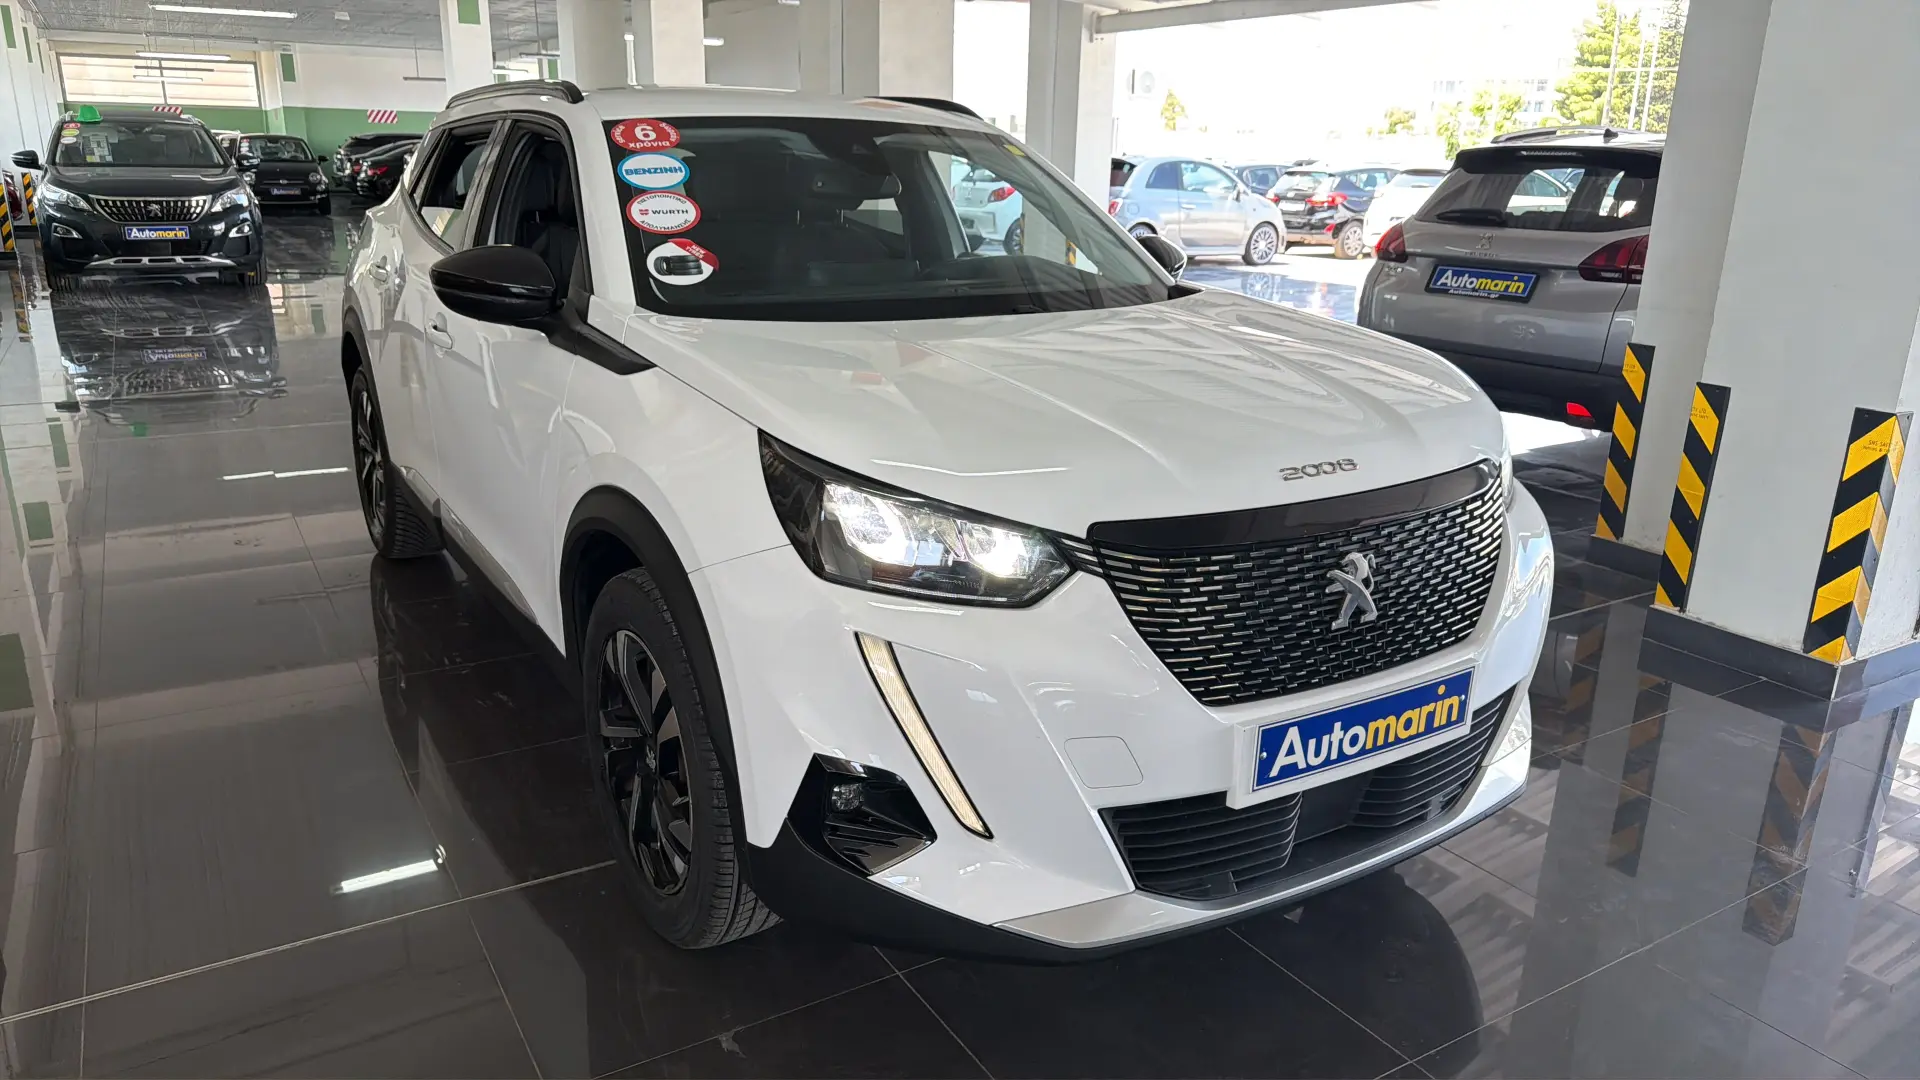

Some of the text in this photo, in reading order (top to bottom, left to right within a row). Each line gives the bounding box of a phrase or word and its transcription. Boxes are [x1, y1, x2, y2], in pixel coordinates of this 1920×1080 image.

[634, 125, 657, 141] 6
[628, 140, 671, 149] χρόνια
[624, 166, 684, 176] ΒΕΝΖΙΝΗ
[130, 227, 186, 238] Automarin
[1437, 270, 1525, 294] Automarin
[1448, 289, 1500, 299] Automarin.gr
[1280, 458, 1360, 481] 2008
[1267, 684, 1460, 778] Automarin
